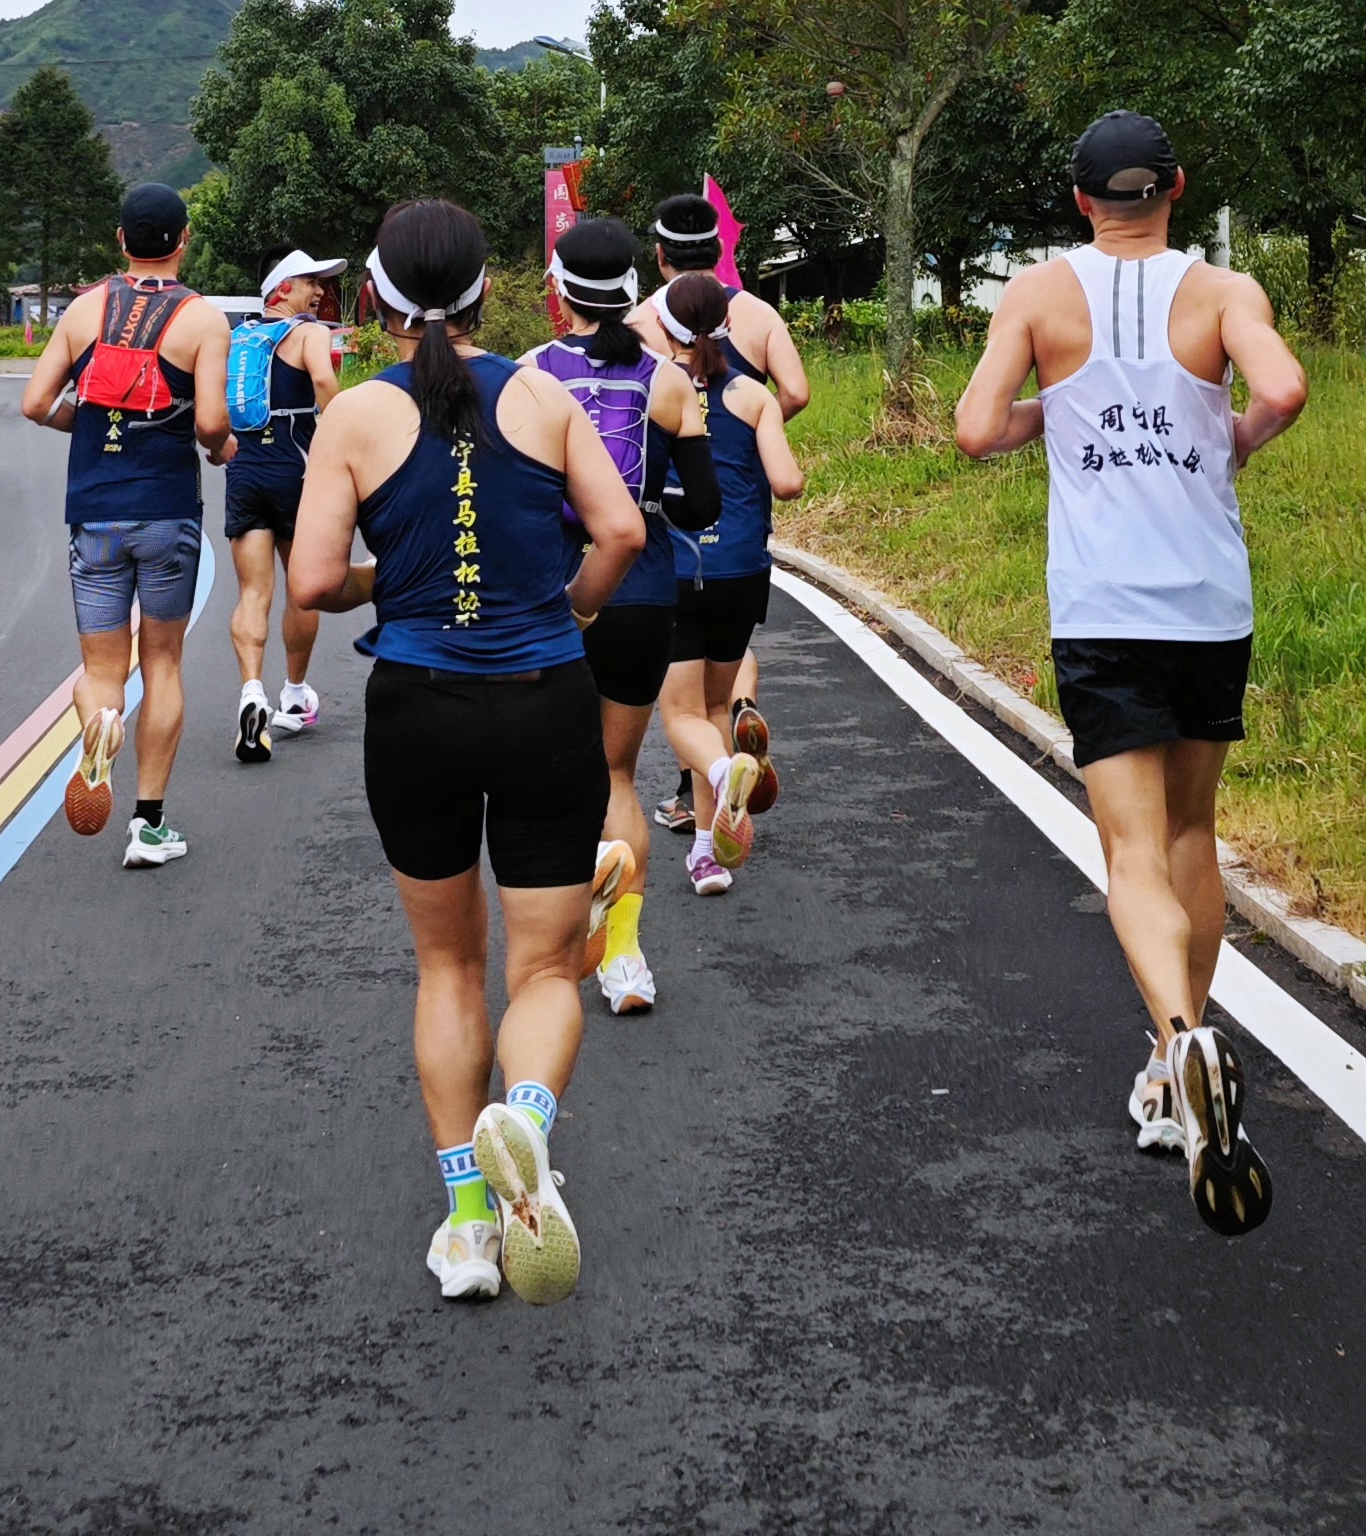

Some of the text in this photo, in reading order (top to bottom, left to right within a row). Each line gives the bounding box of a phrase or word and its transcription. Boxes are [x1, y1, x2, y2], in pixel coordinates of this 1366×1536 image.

[1098, 401, 1174, 436] 周宁县
[450, 426, 481, 628] 宁县马拉松协
